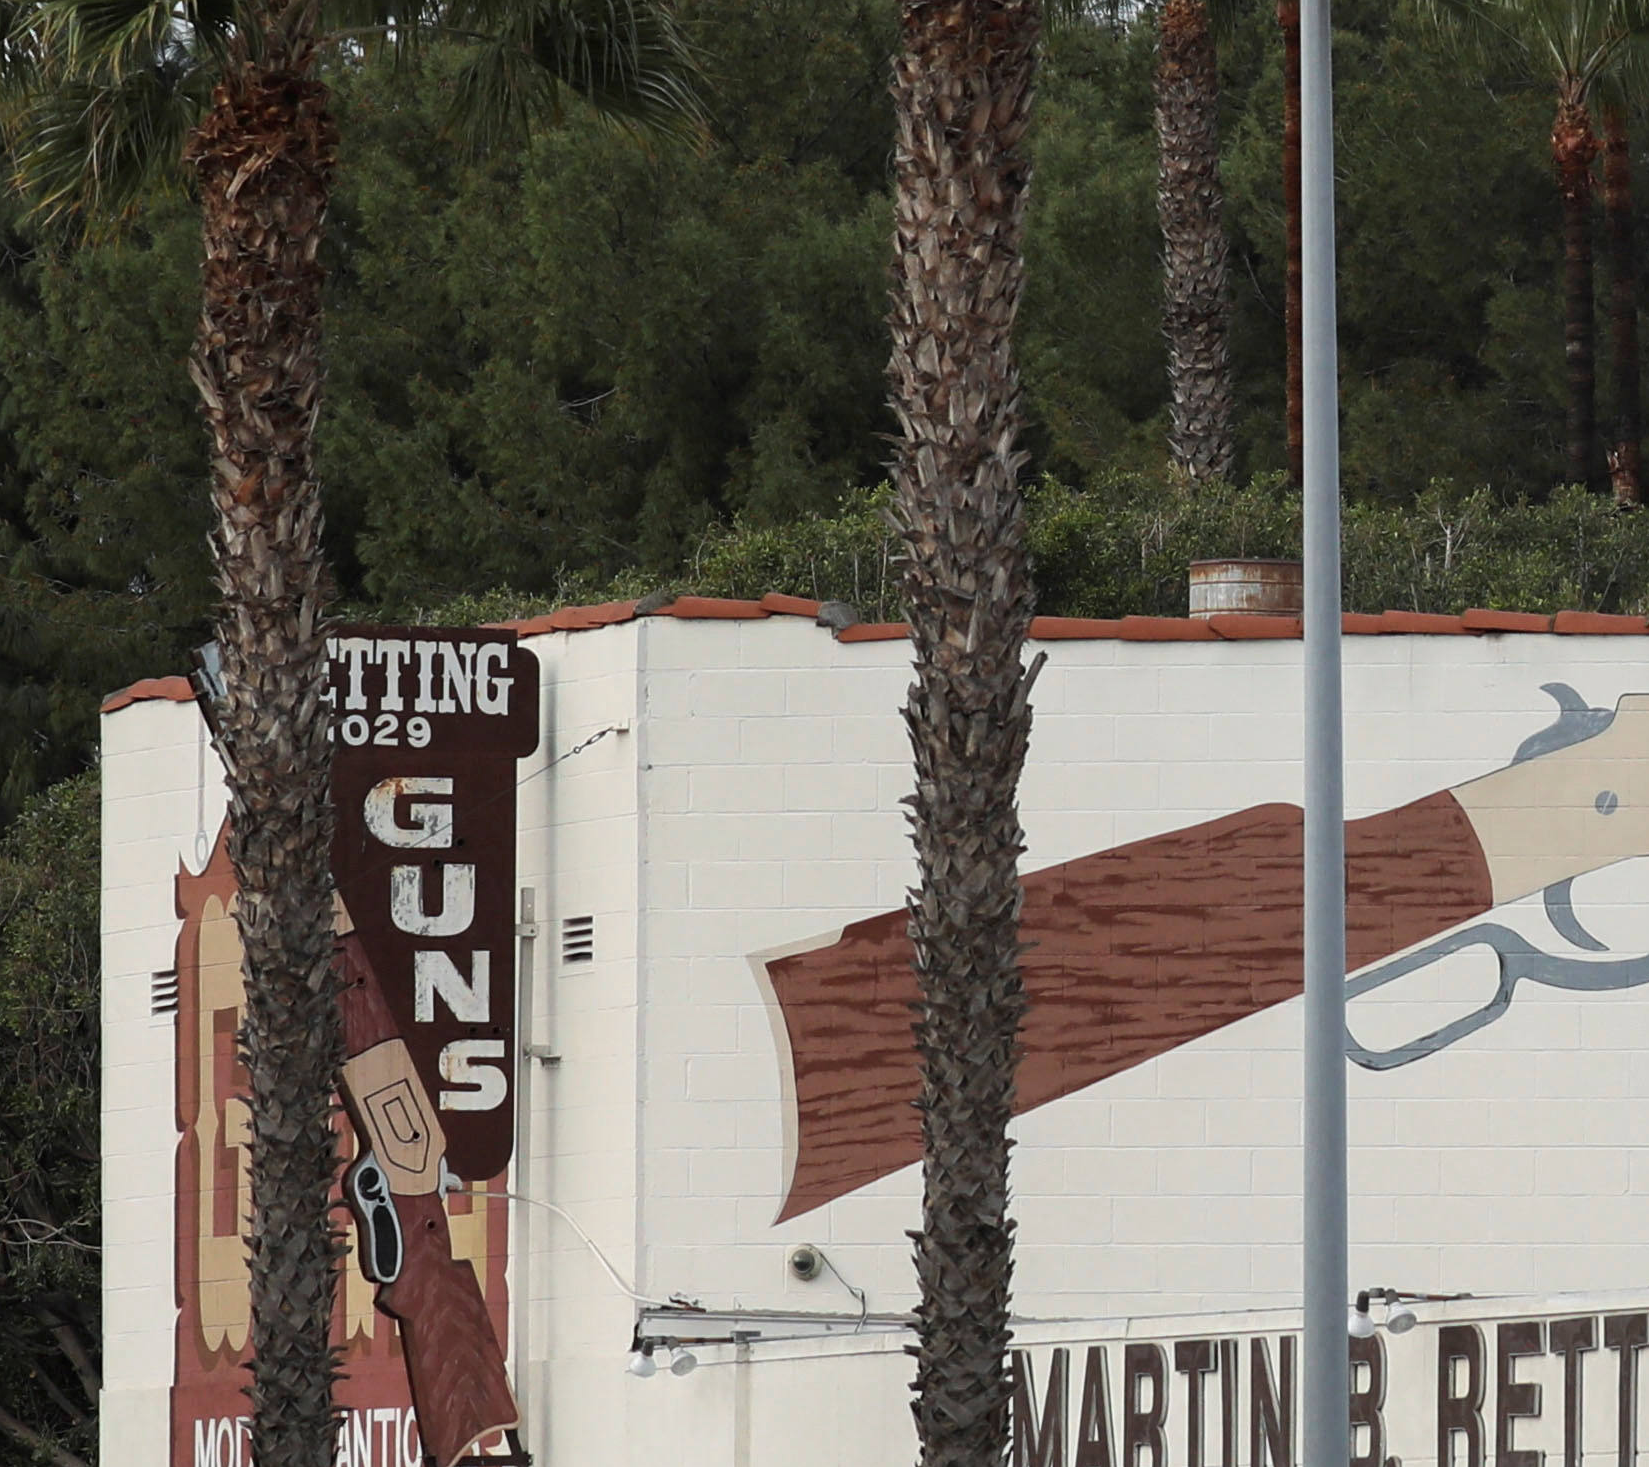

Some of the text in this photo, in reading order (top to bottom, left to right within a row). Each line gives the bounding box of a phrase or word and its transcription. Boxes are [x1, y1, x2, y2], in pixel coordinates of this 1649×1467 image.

[318, 637, 514, 716] TTING
[327, 714, 431, 748] 029
[363, 777, 508, 1111] GUNS
